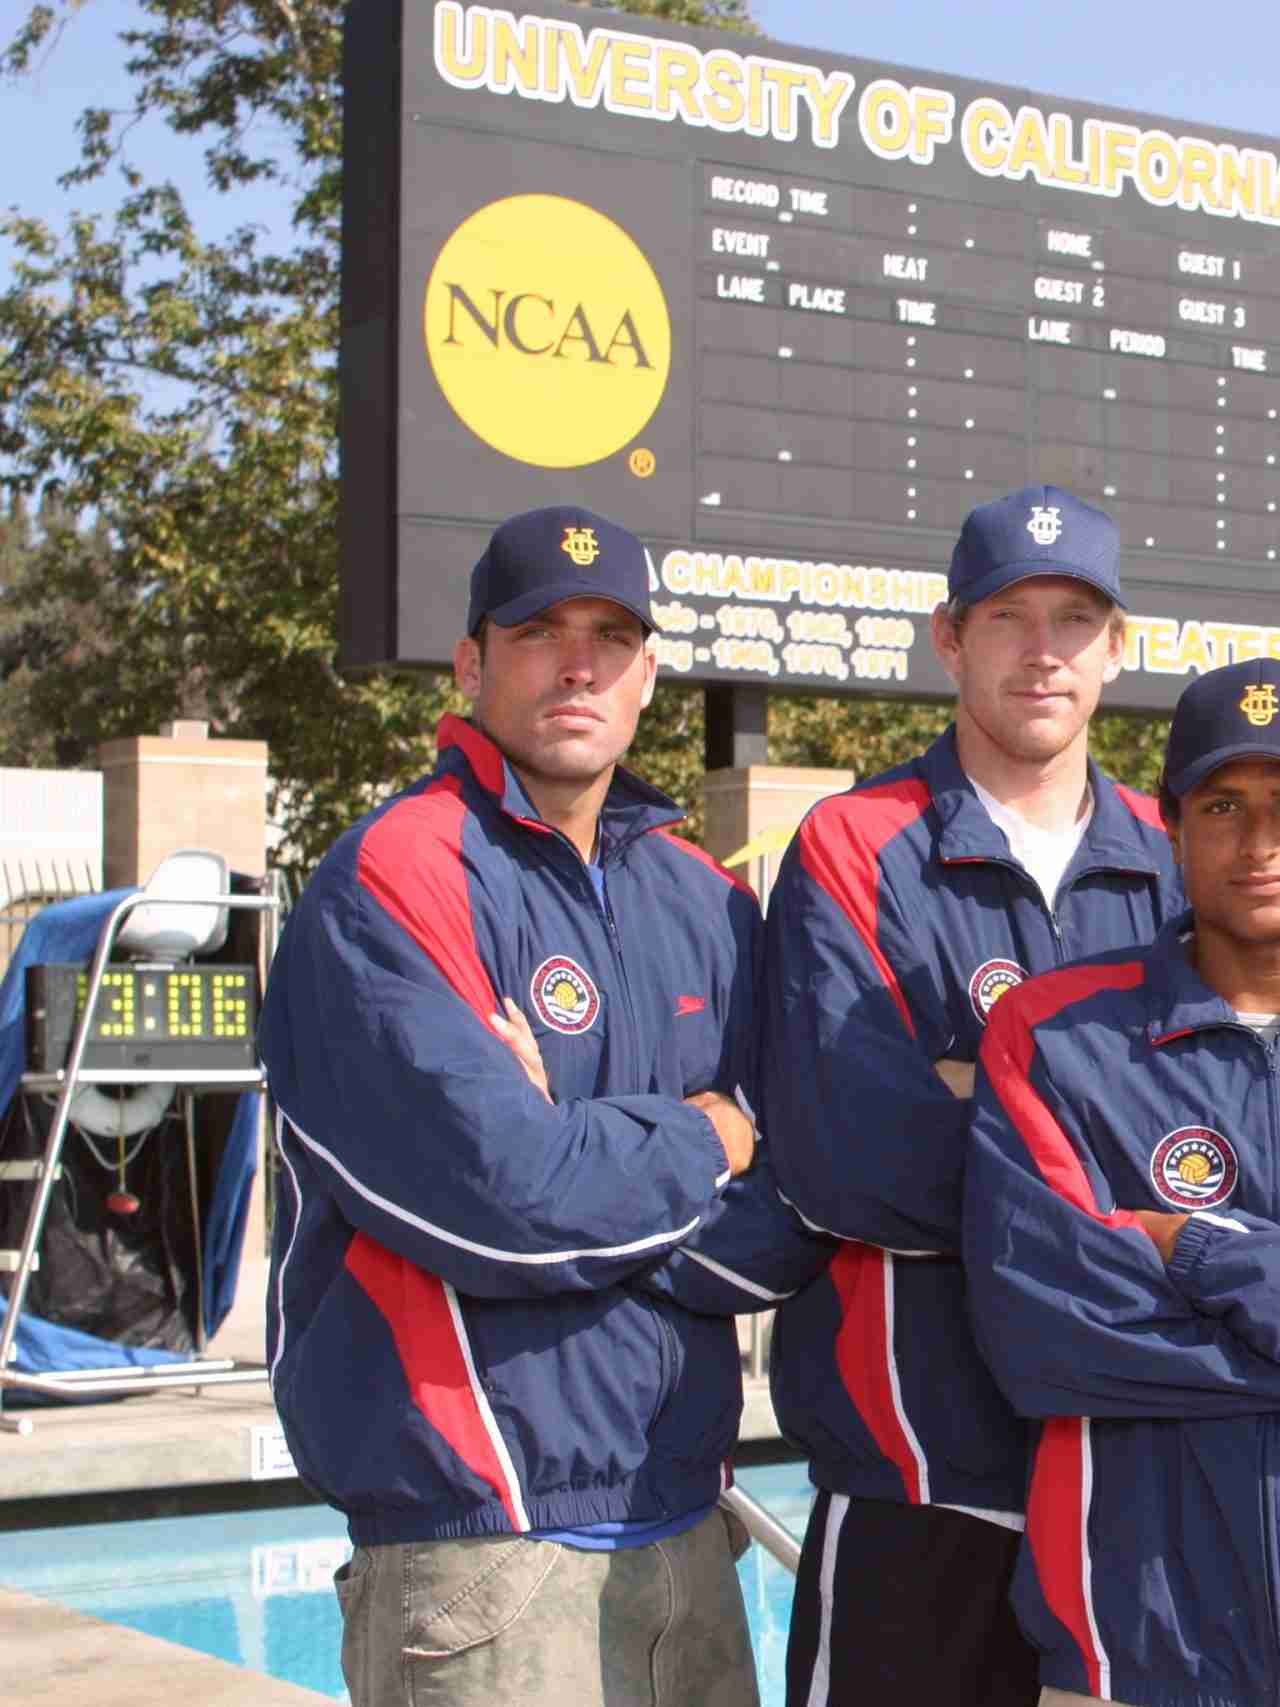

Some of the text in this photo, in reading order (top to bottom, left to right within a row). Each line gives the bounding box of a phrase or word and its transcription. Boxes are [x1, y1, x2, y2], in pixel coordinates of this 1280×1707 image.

[434, 1, 855, 148] UNIVERSITY
[859, 80, 956, 165] OF
[711, 176, 829, 215] RECORD TIME
[712, 228, 770, 257] EVENT
[1047, 229, 1092, 257] HOME
[883, 253, 928, 281] HEAT
[1178, 251, 1241, 281] GUEST 1
[717, 274, 765, 303] LANE
[789, 283, 846, 314] PLACE
[1034, 276, 1105, 308] GUEST 2
[442, 281, 655, 369] NCAA
[897, 299, 936, 326] TIME
[1178, 298, 1247, 328] GUEST 3
[1028, 315, 1071, 344] LANE
[1109, 328, 1166, 357] PERIOD
[1231, 346, 1267, 371] TIME
